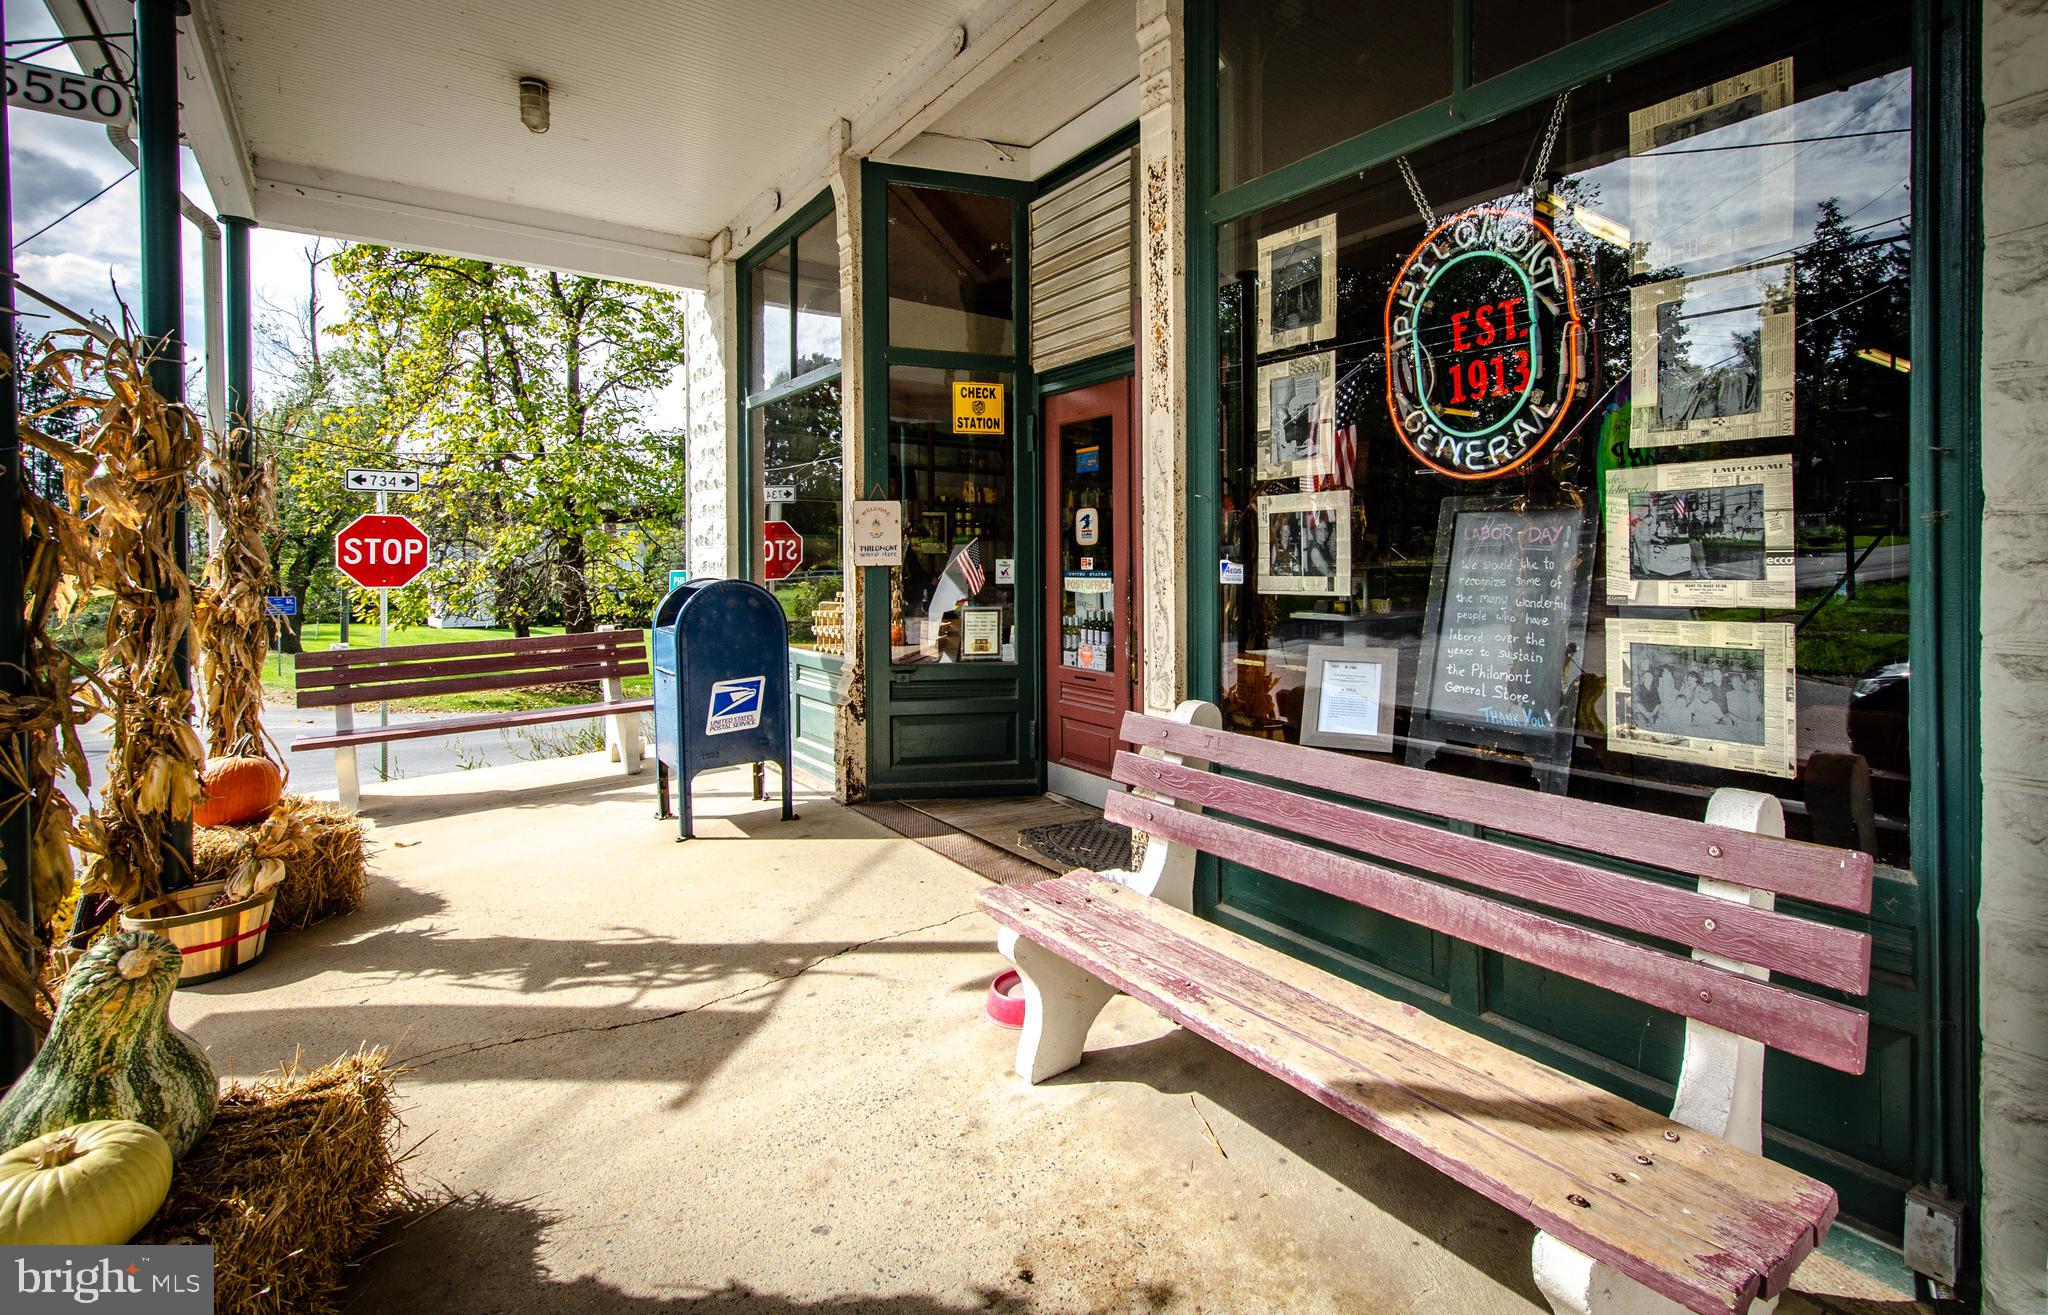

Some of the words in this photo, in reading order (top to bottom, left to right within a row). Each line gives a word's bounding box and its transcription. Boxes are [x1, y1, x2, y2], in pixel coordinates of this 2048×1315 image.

[1450, 297, 1529, 353] EST.
[1449, 350, 1531, 404] 1913
[960, 386, 997, 400] CHECK
[957, 416, 1000, 430] STATION
[1404, 400, 1559, 472] GENERAL
[370, 475, 397, 487] 734
[1463, 524, 1513, 544] LABOR
[343, 537, 423, 565] STOP
[1520, 557, 1539, 570] like
[1543, 556, 1555, 570] to
[1766, 556, 1793, 565] ecco
[1066, 580, 1085, 589] POST
[1086, 580, 1110, 590] OFFICE
[1459, 577, 1507, 590] recognize
[1550, 575, 1562, 589] of
[1456, 592, 1473, 603] the
[1480, 594, 1508, 609] many
[1515, 595, 1567, 611] wonderful
[1457, 610, 1487, 625] people
[1525, 613, 1550, 626] have
[1449, 628, 1484, 643] labored
[1494, 634, 1520, 644] over
[1525, 632, 1546, 647] the
[1447, 647, 1474, 658] years
[1480, 647, 1490, 657] to
[1498, 649, 1543, 663] sustain
[1446, 664, 1465, 677] the
[1471, 663, 1532, 684] Philomont
[1445, 681, 1487, 697] General
[709, 723, 731, 732] POSTAL
[732, 721, 756, 729] SERVICE
[710, 717, 733, 726] UNITED
